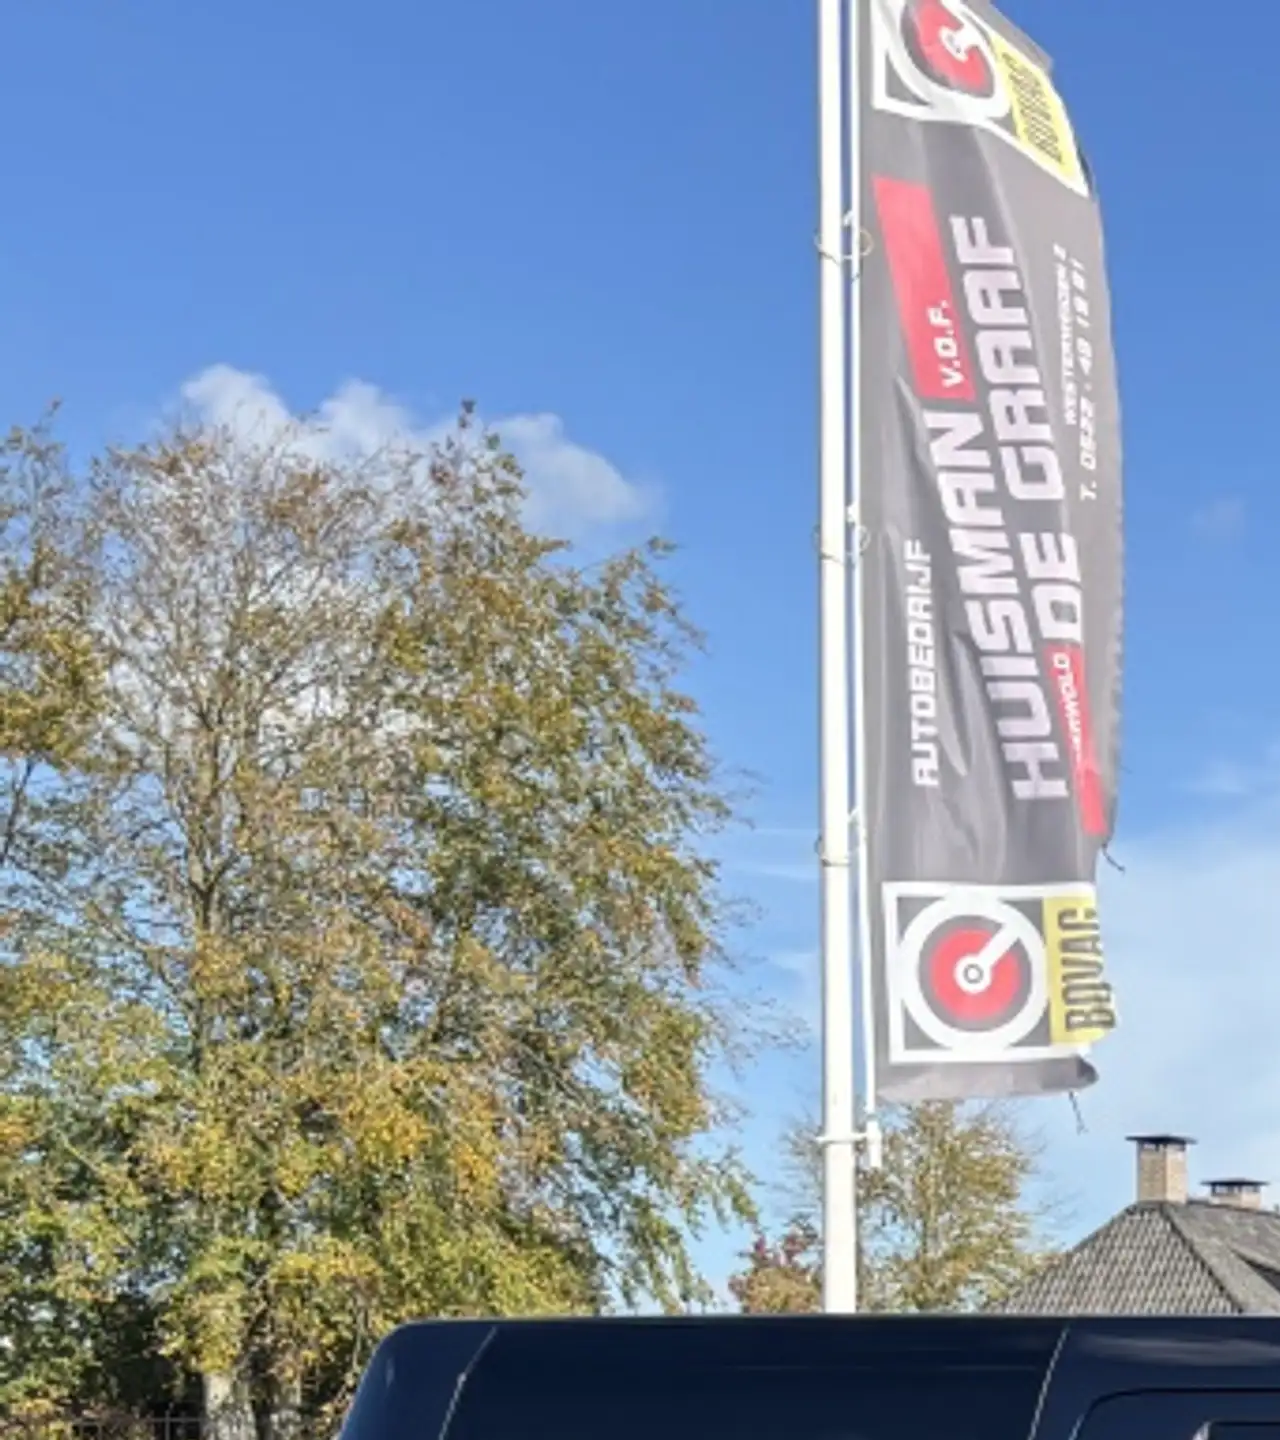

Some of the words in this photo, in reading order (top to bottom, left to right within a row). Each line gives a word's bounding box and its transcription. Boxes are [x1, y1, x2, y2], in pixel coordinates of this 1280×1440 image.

[927, 300, 964, 388] V.O.F.
[949, 216, 1065, 500] GRAAF
[1080, 479, 1097, 501] T.
[923, 410, 1069, 799] HUISMAN
[1018, 532, 1083, 643] DE
[904, 540, 939, 786] AUTOBEDRIJF
[1058, 907, 1116, 1032] BOVAG
